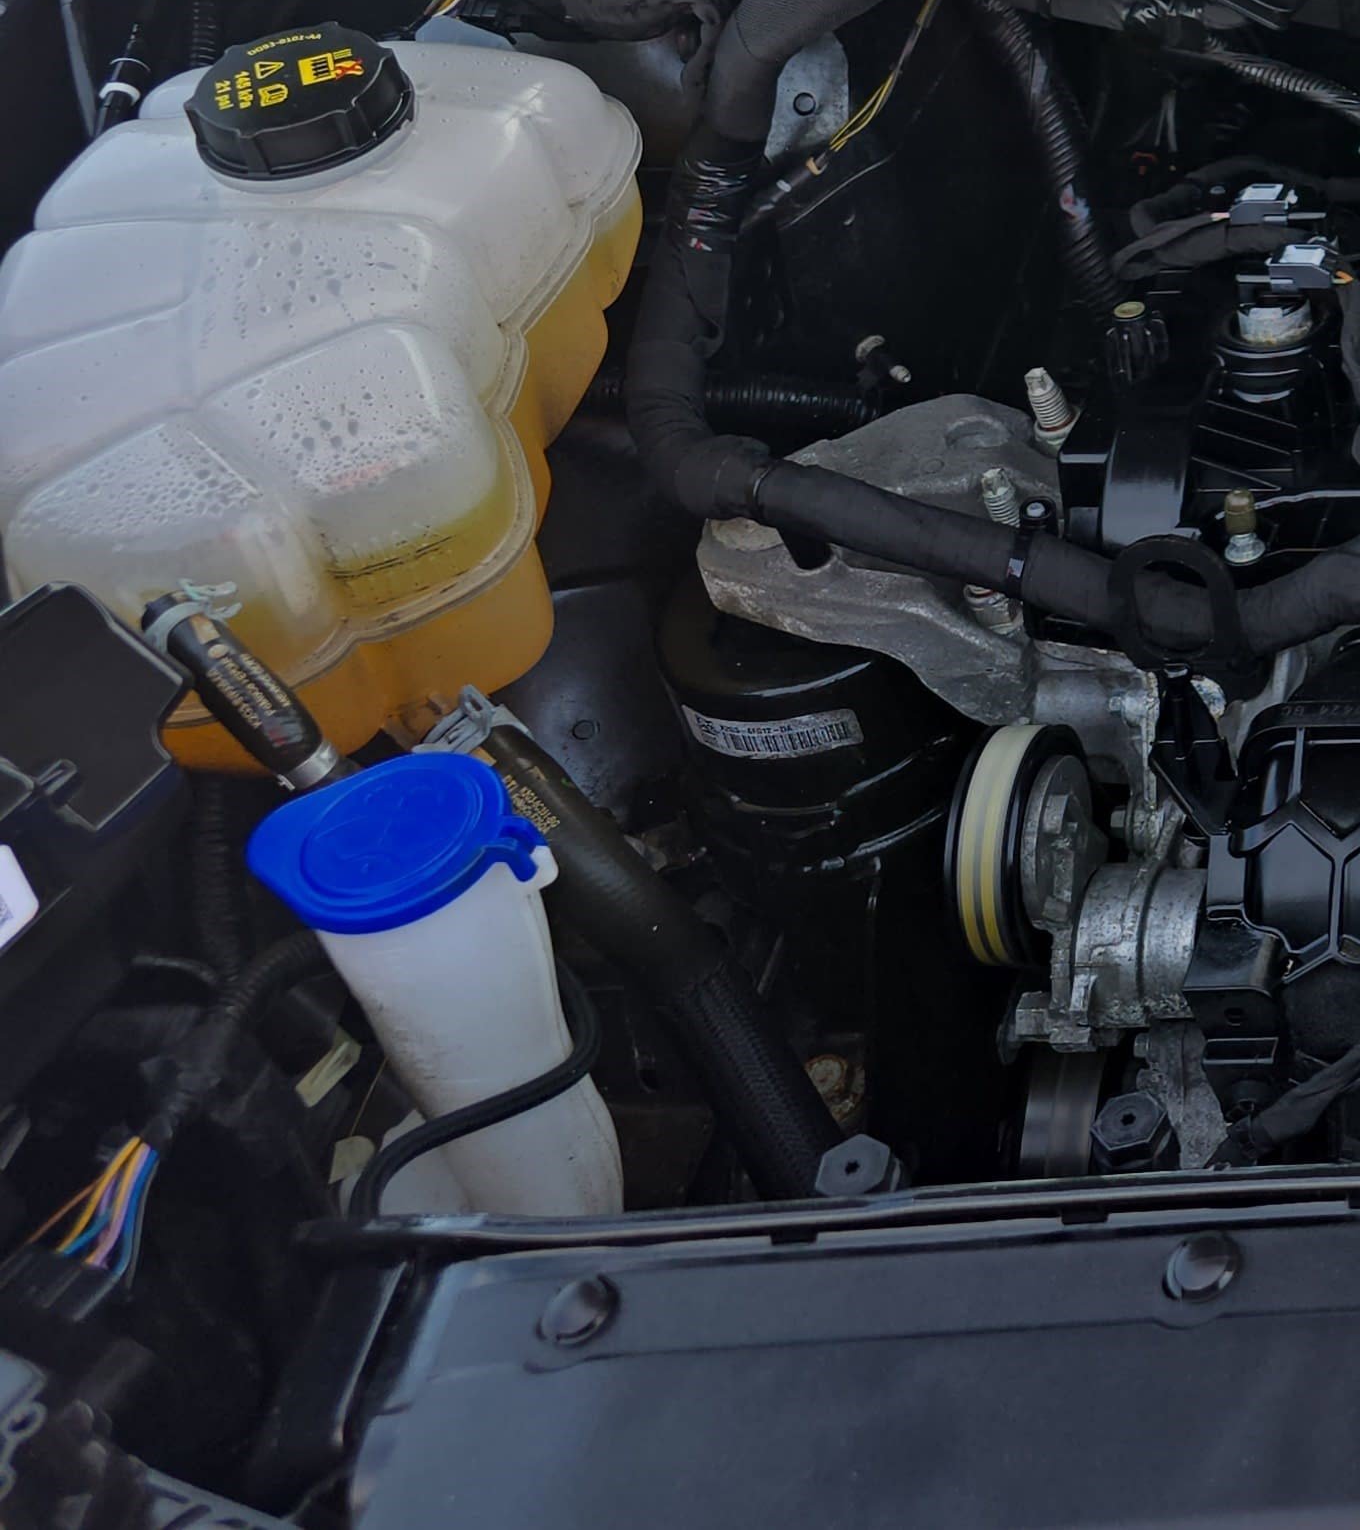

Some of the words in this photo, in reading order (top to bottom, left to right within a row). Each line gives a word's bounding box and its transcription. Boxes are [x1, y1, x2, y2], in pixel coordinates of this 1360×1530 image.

[214, 80, 232, 94] 21
[234, 71, 252, 90] 145
[214, 94, 235, 111] psi
[237, 88, 255, 109] kPa
